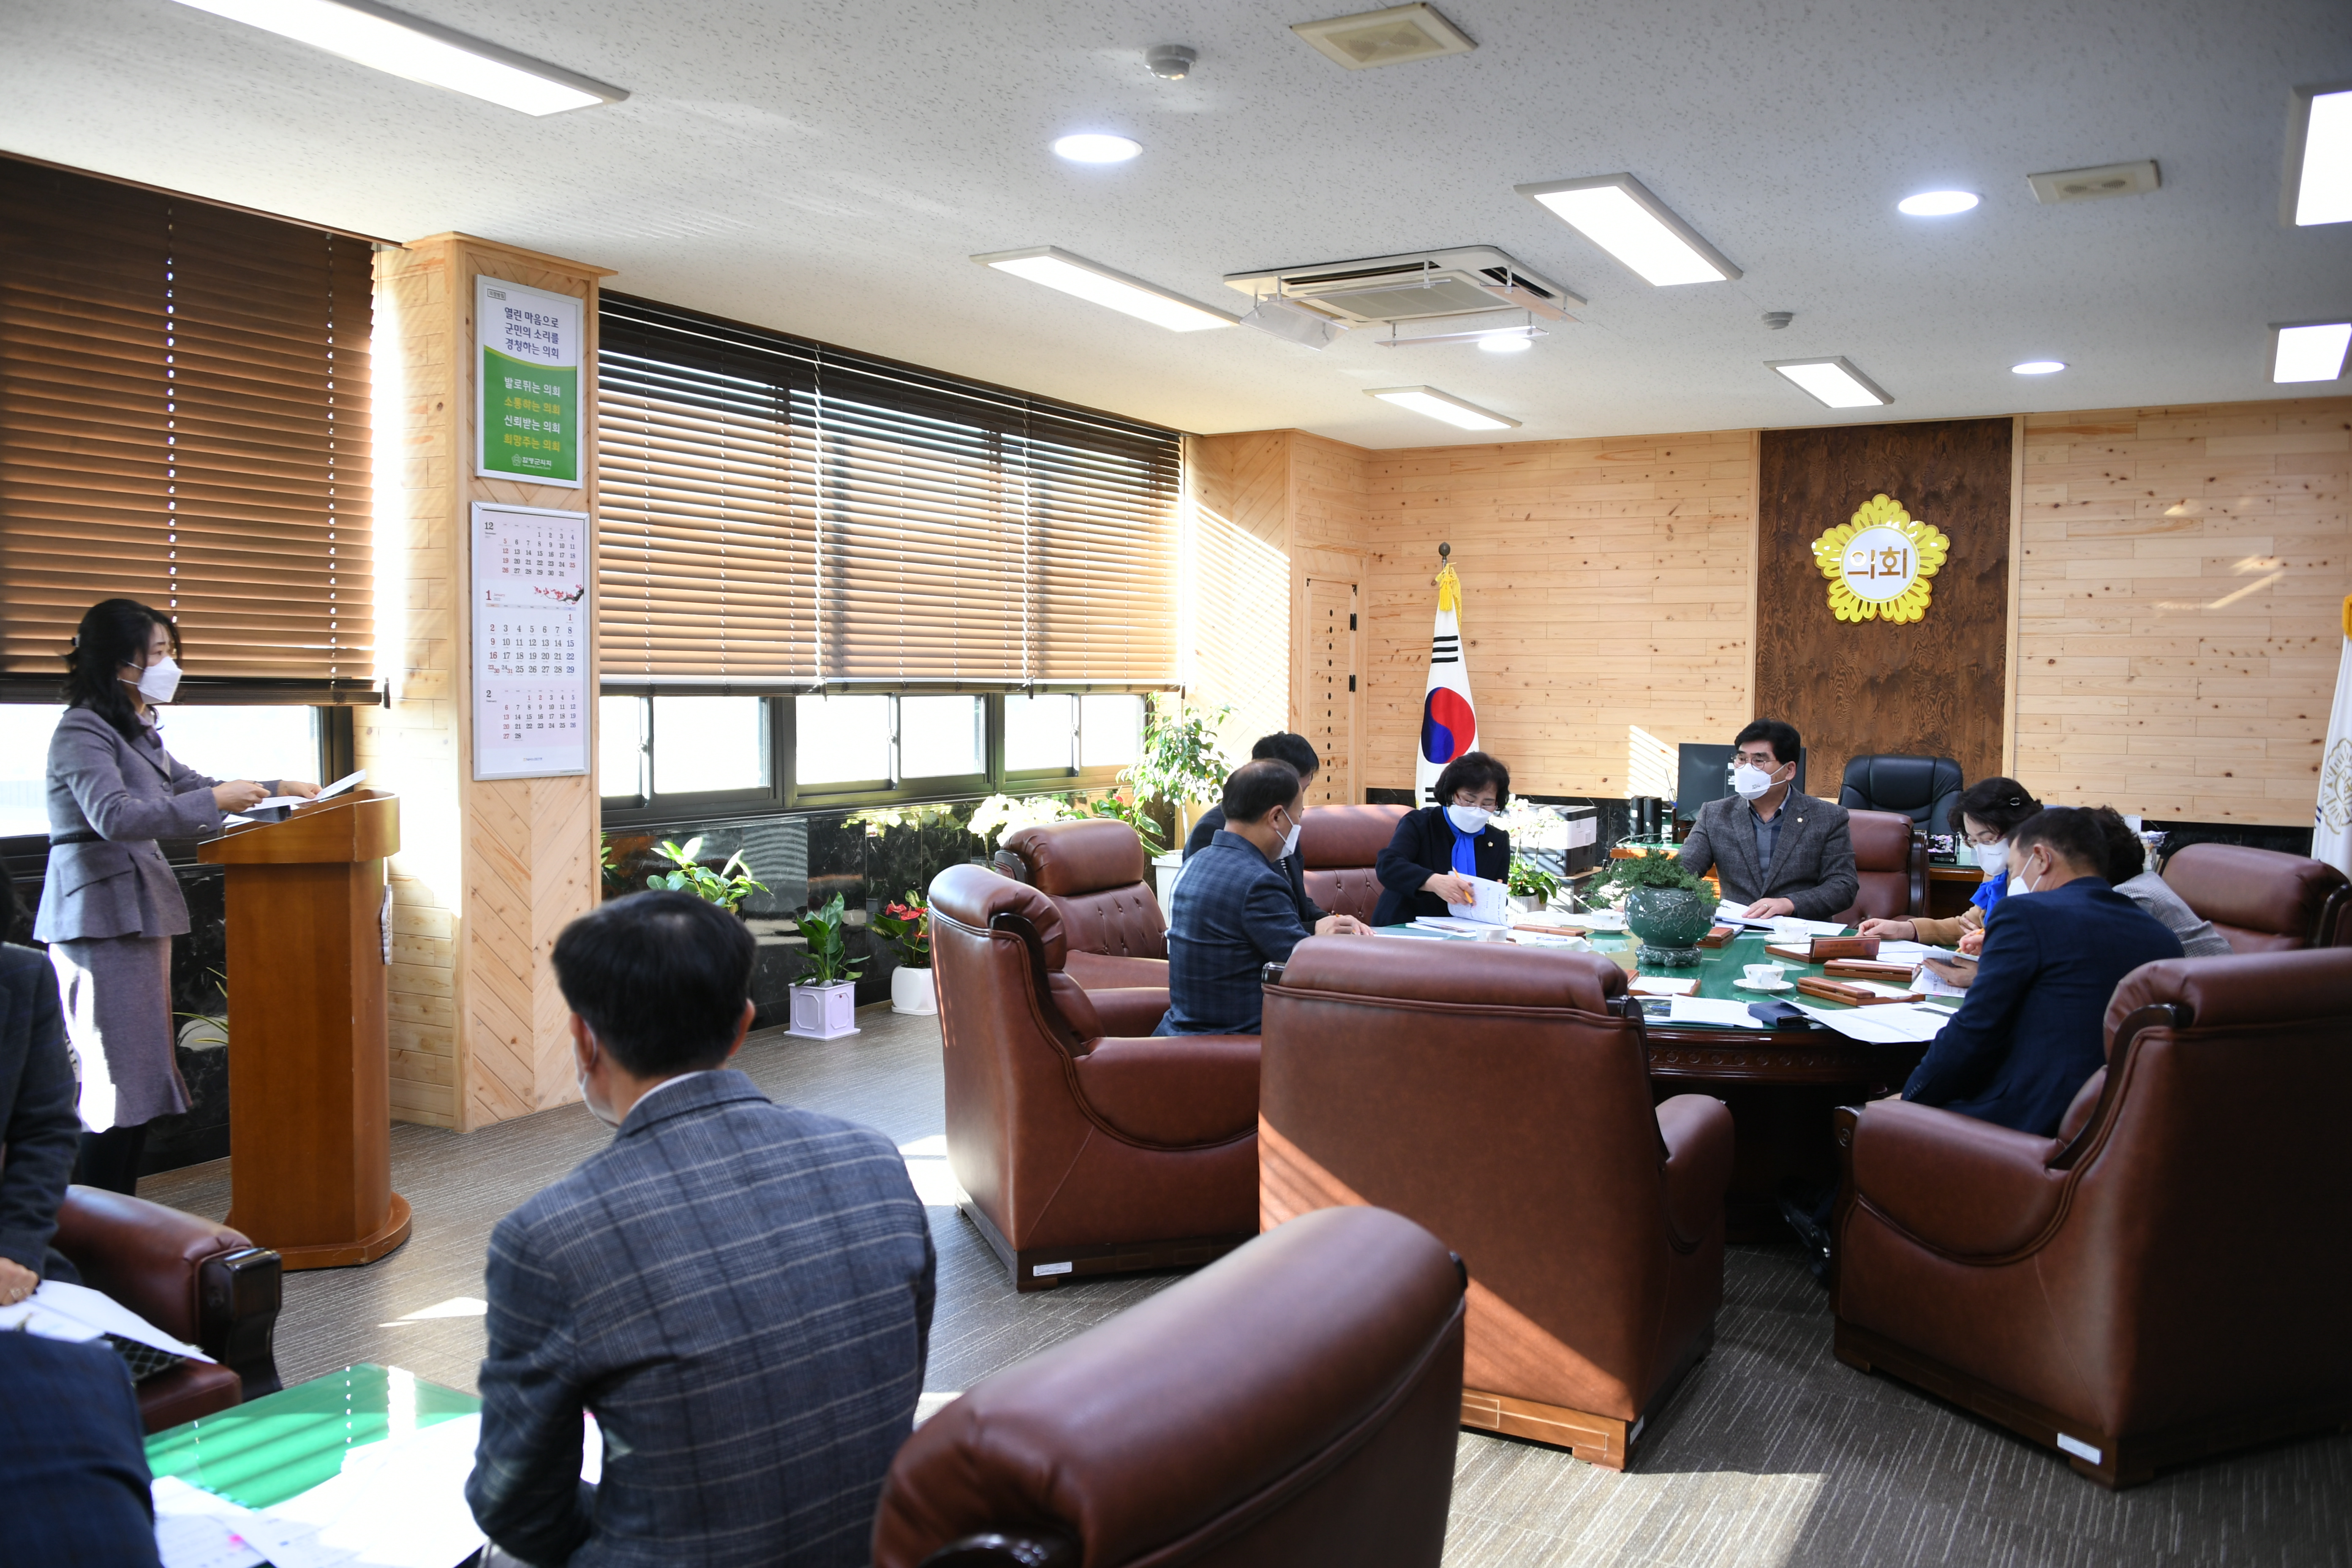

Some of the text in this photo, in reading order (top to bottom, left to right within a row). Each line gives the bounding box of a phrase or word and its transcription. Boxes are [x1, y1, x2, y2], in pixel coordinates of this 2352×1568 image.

[505, 307, 559, 328] 열린 마음으로
[505, 322, 559, 344] 군민의 소리를
[505, 338, 558, 359] 경청하는 의회
[504, 377, 560, 397] 발로뛰는 의회
[504, 397, 560, 416] 소통하는 의회
[504, 415, 560, 434] 신뢰받는 의회
[504, 434, 560, 452] 희망주는 의회
[1847, 546, 1907, 579] 의회
[486, 590, 491, 600] 1
